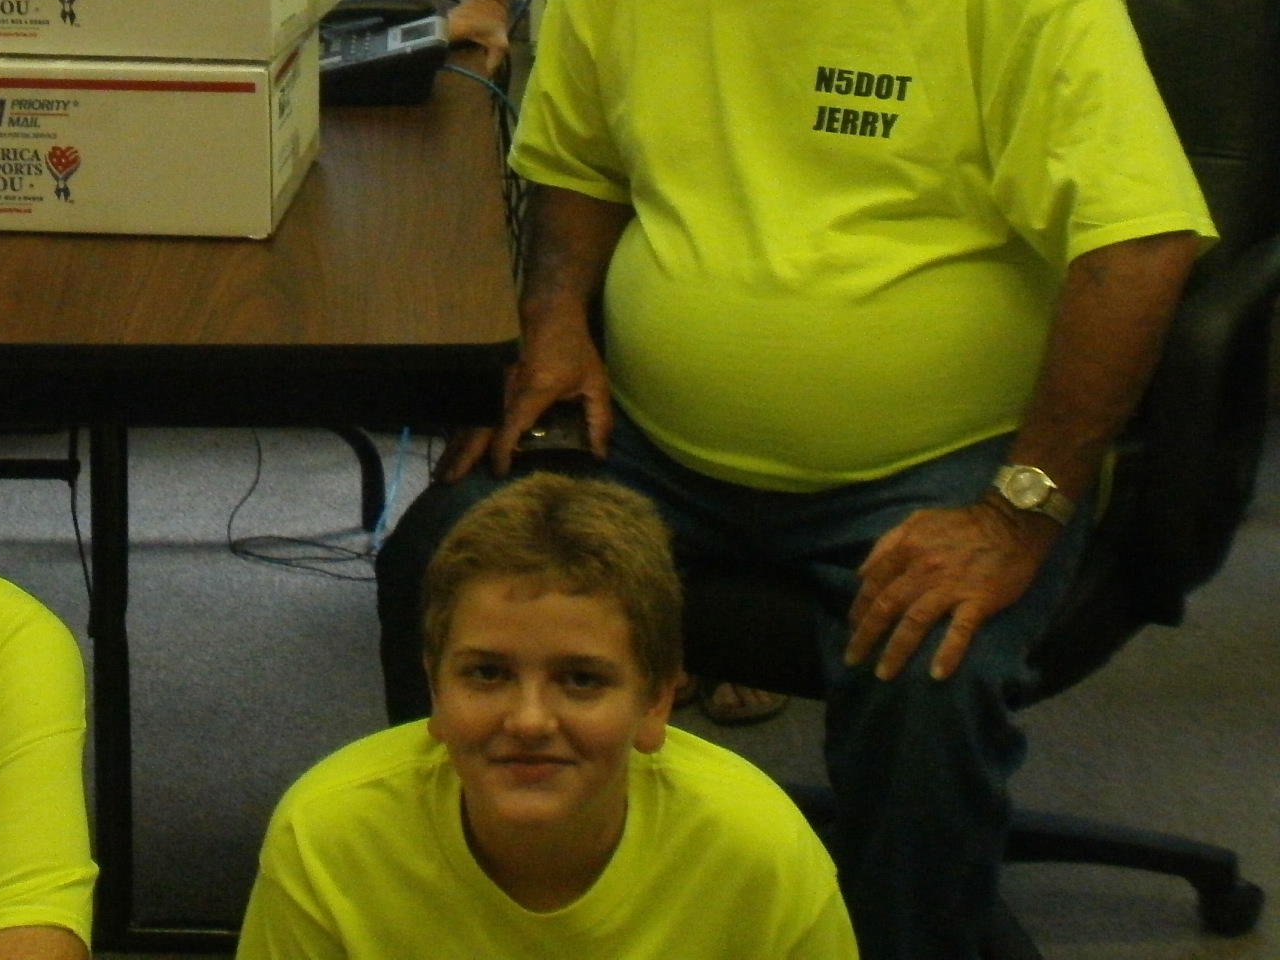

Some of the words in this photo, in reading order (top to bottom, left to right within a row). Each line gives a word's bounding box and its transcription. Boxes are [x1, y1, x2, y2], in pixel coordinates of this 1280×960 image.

[814, 66, 912, 102] N5DOT
[11, 99, 70, 110] PRIORITY
[8, 117, 40, 128] MAIL
[813, 105, 899, 139] JERRY
